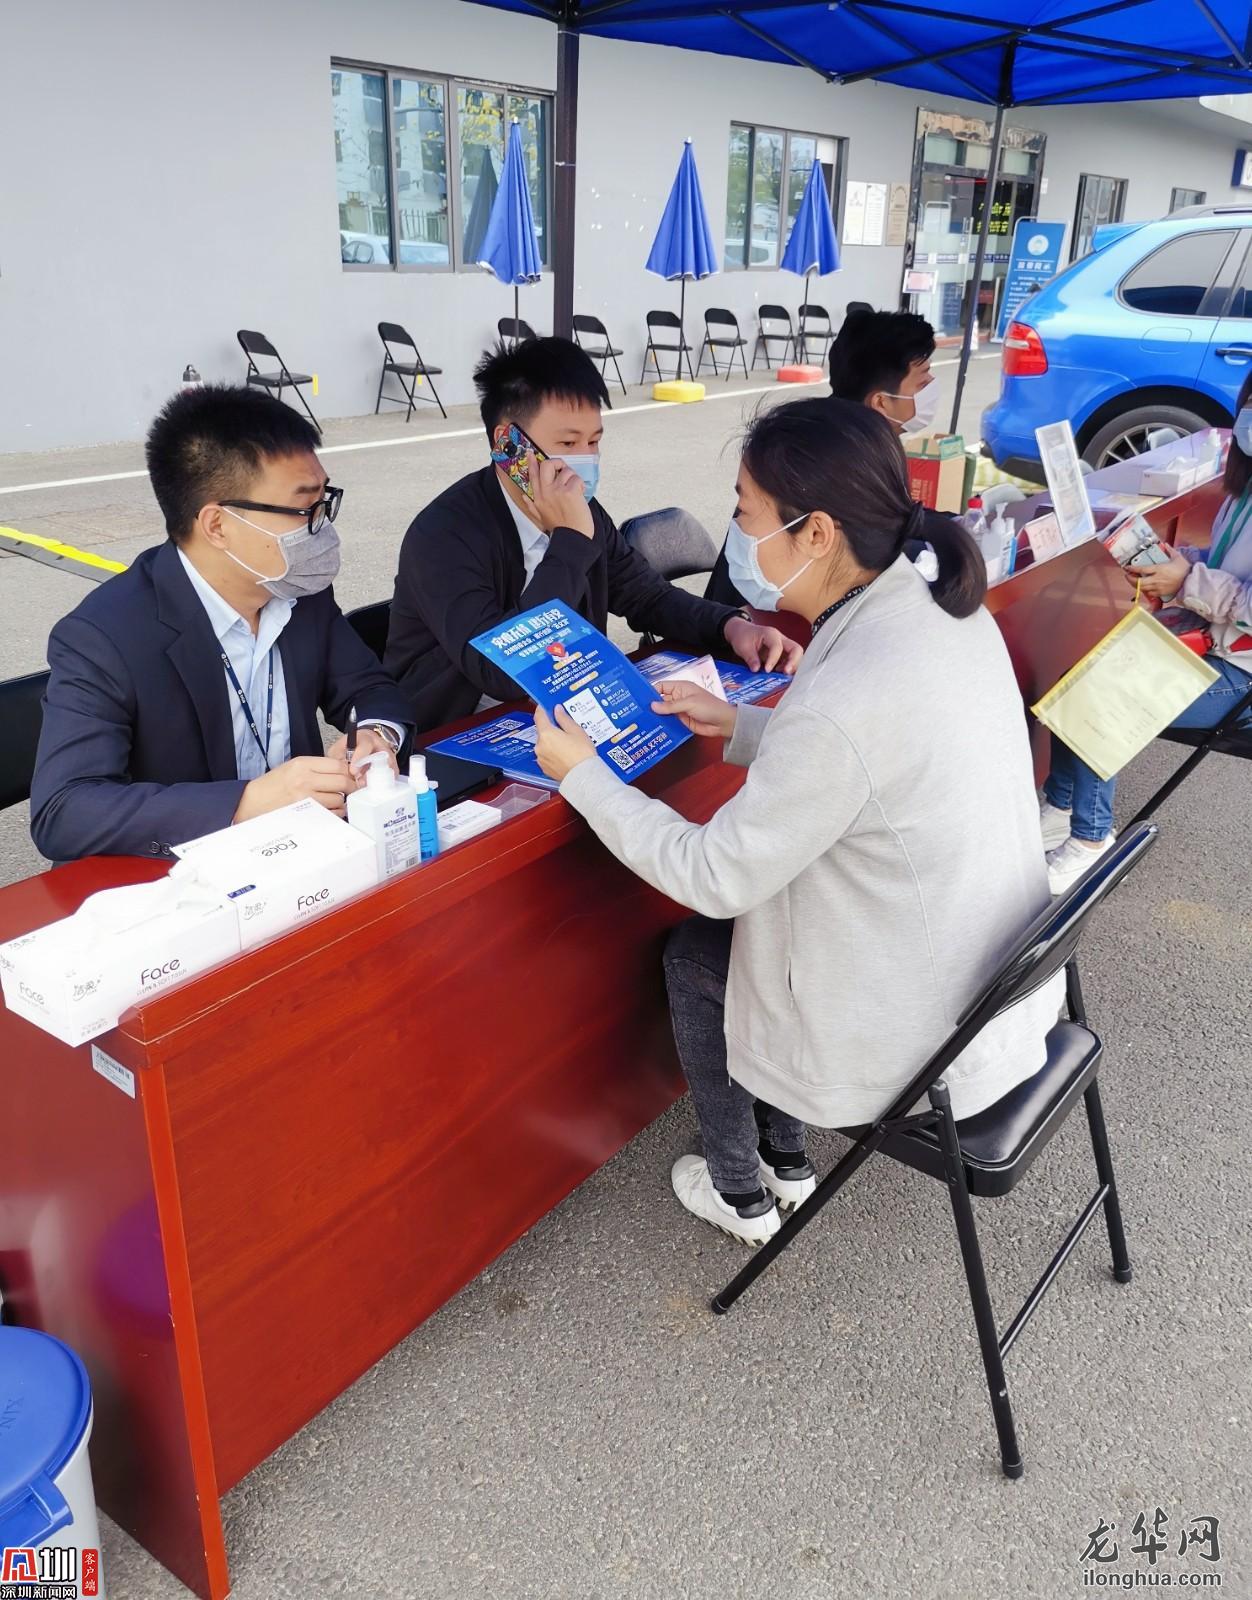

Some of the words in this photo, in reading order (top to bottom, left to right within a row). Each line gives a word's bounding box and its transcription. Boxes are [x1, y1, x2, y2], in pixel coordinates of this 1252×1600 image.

[261, 839, 298, 857] Face
[297, 888, 330, 910] Face
[141, 959, 180, 985] Face
[19, 981, 45, 1005] Face
